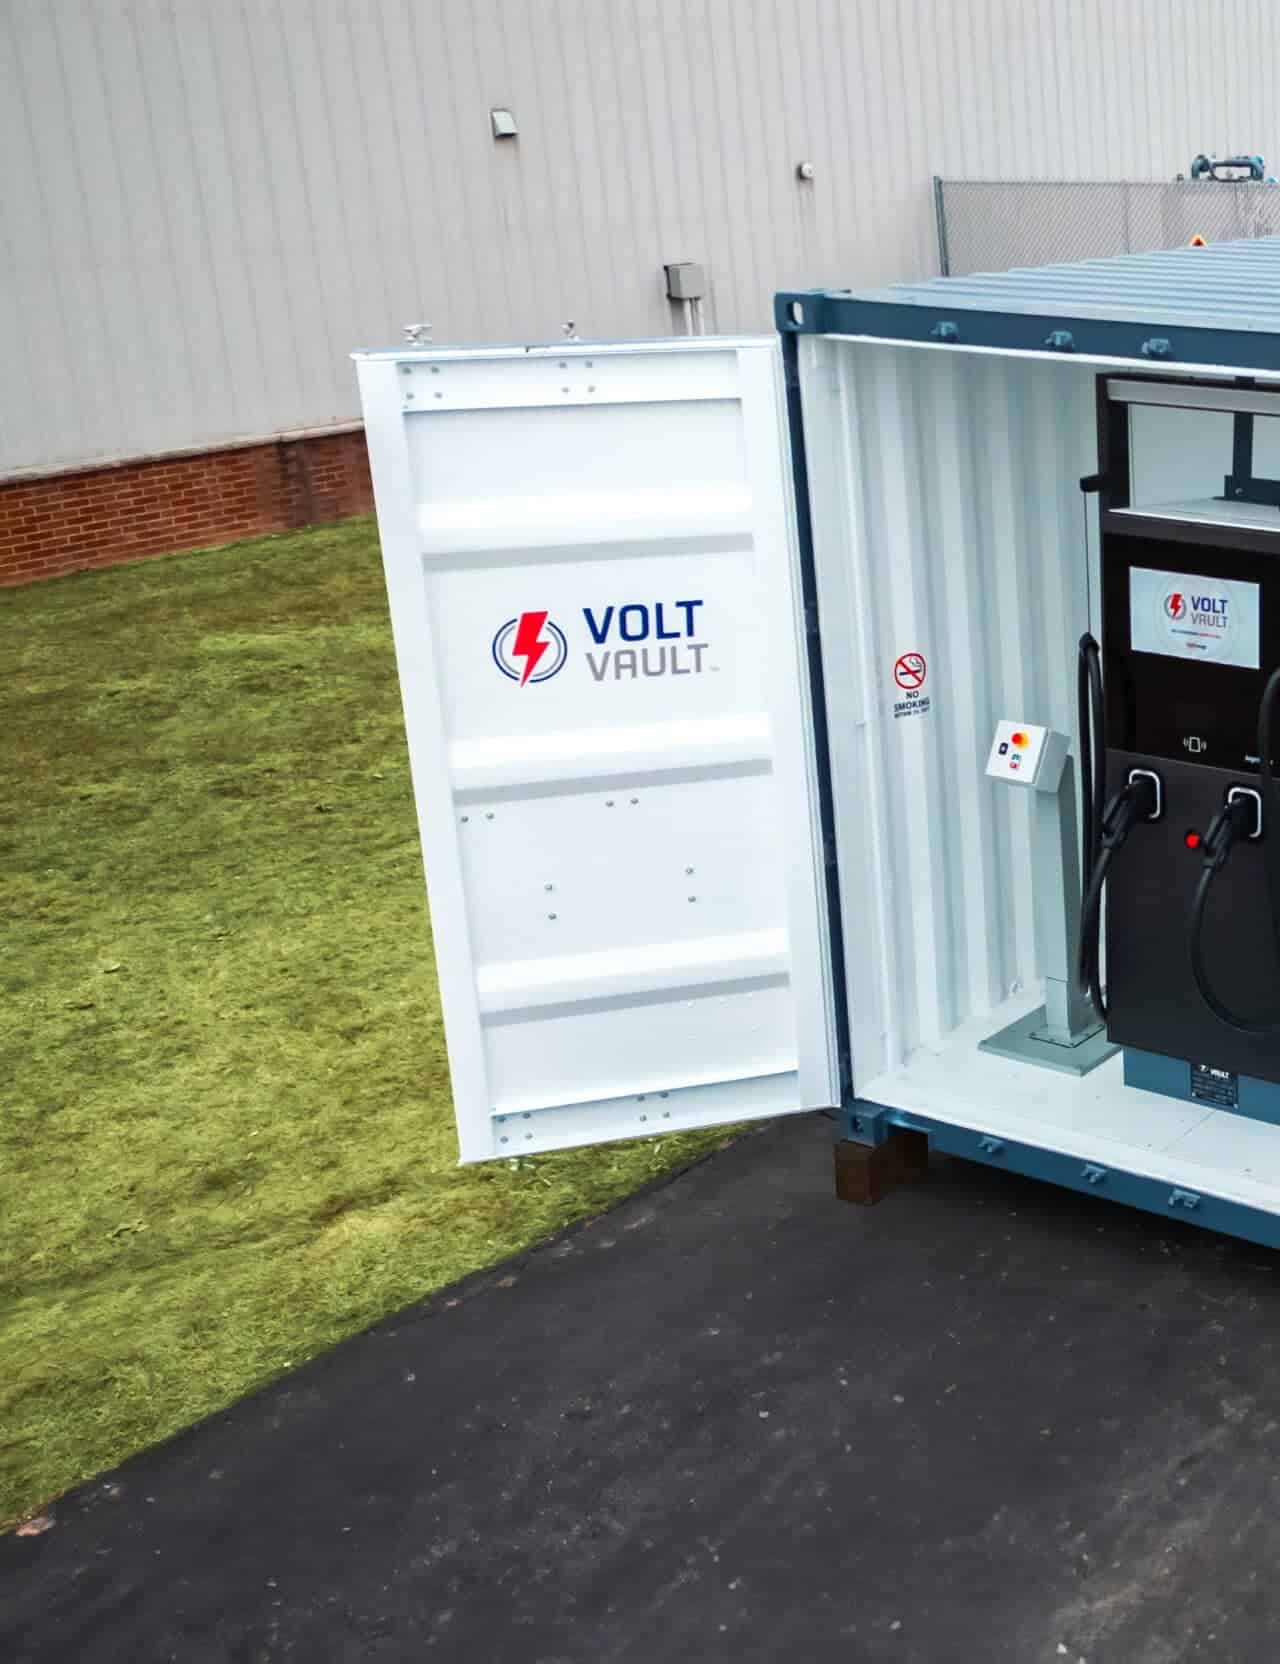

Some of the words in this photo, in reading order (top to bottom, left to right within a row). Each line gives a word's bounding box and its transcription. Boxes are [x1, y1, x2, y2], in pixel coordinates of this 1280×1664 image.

[1191, 595, 1228, 614] VOLT
[582, 600, 704, 644] VOLT
[1191, 613, 1228, 628] VAULT
[585, 643, 709, 682] VAULT
[906, 690, 919, 699] NO
[894, 696, 930, 712] SMOKING
